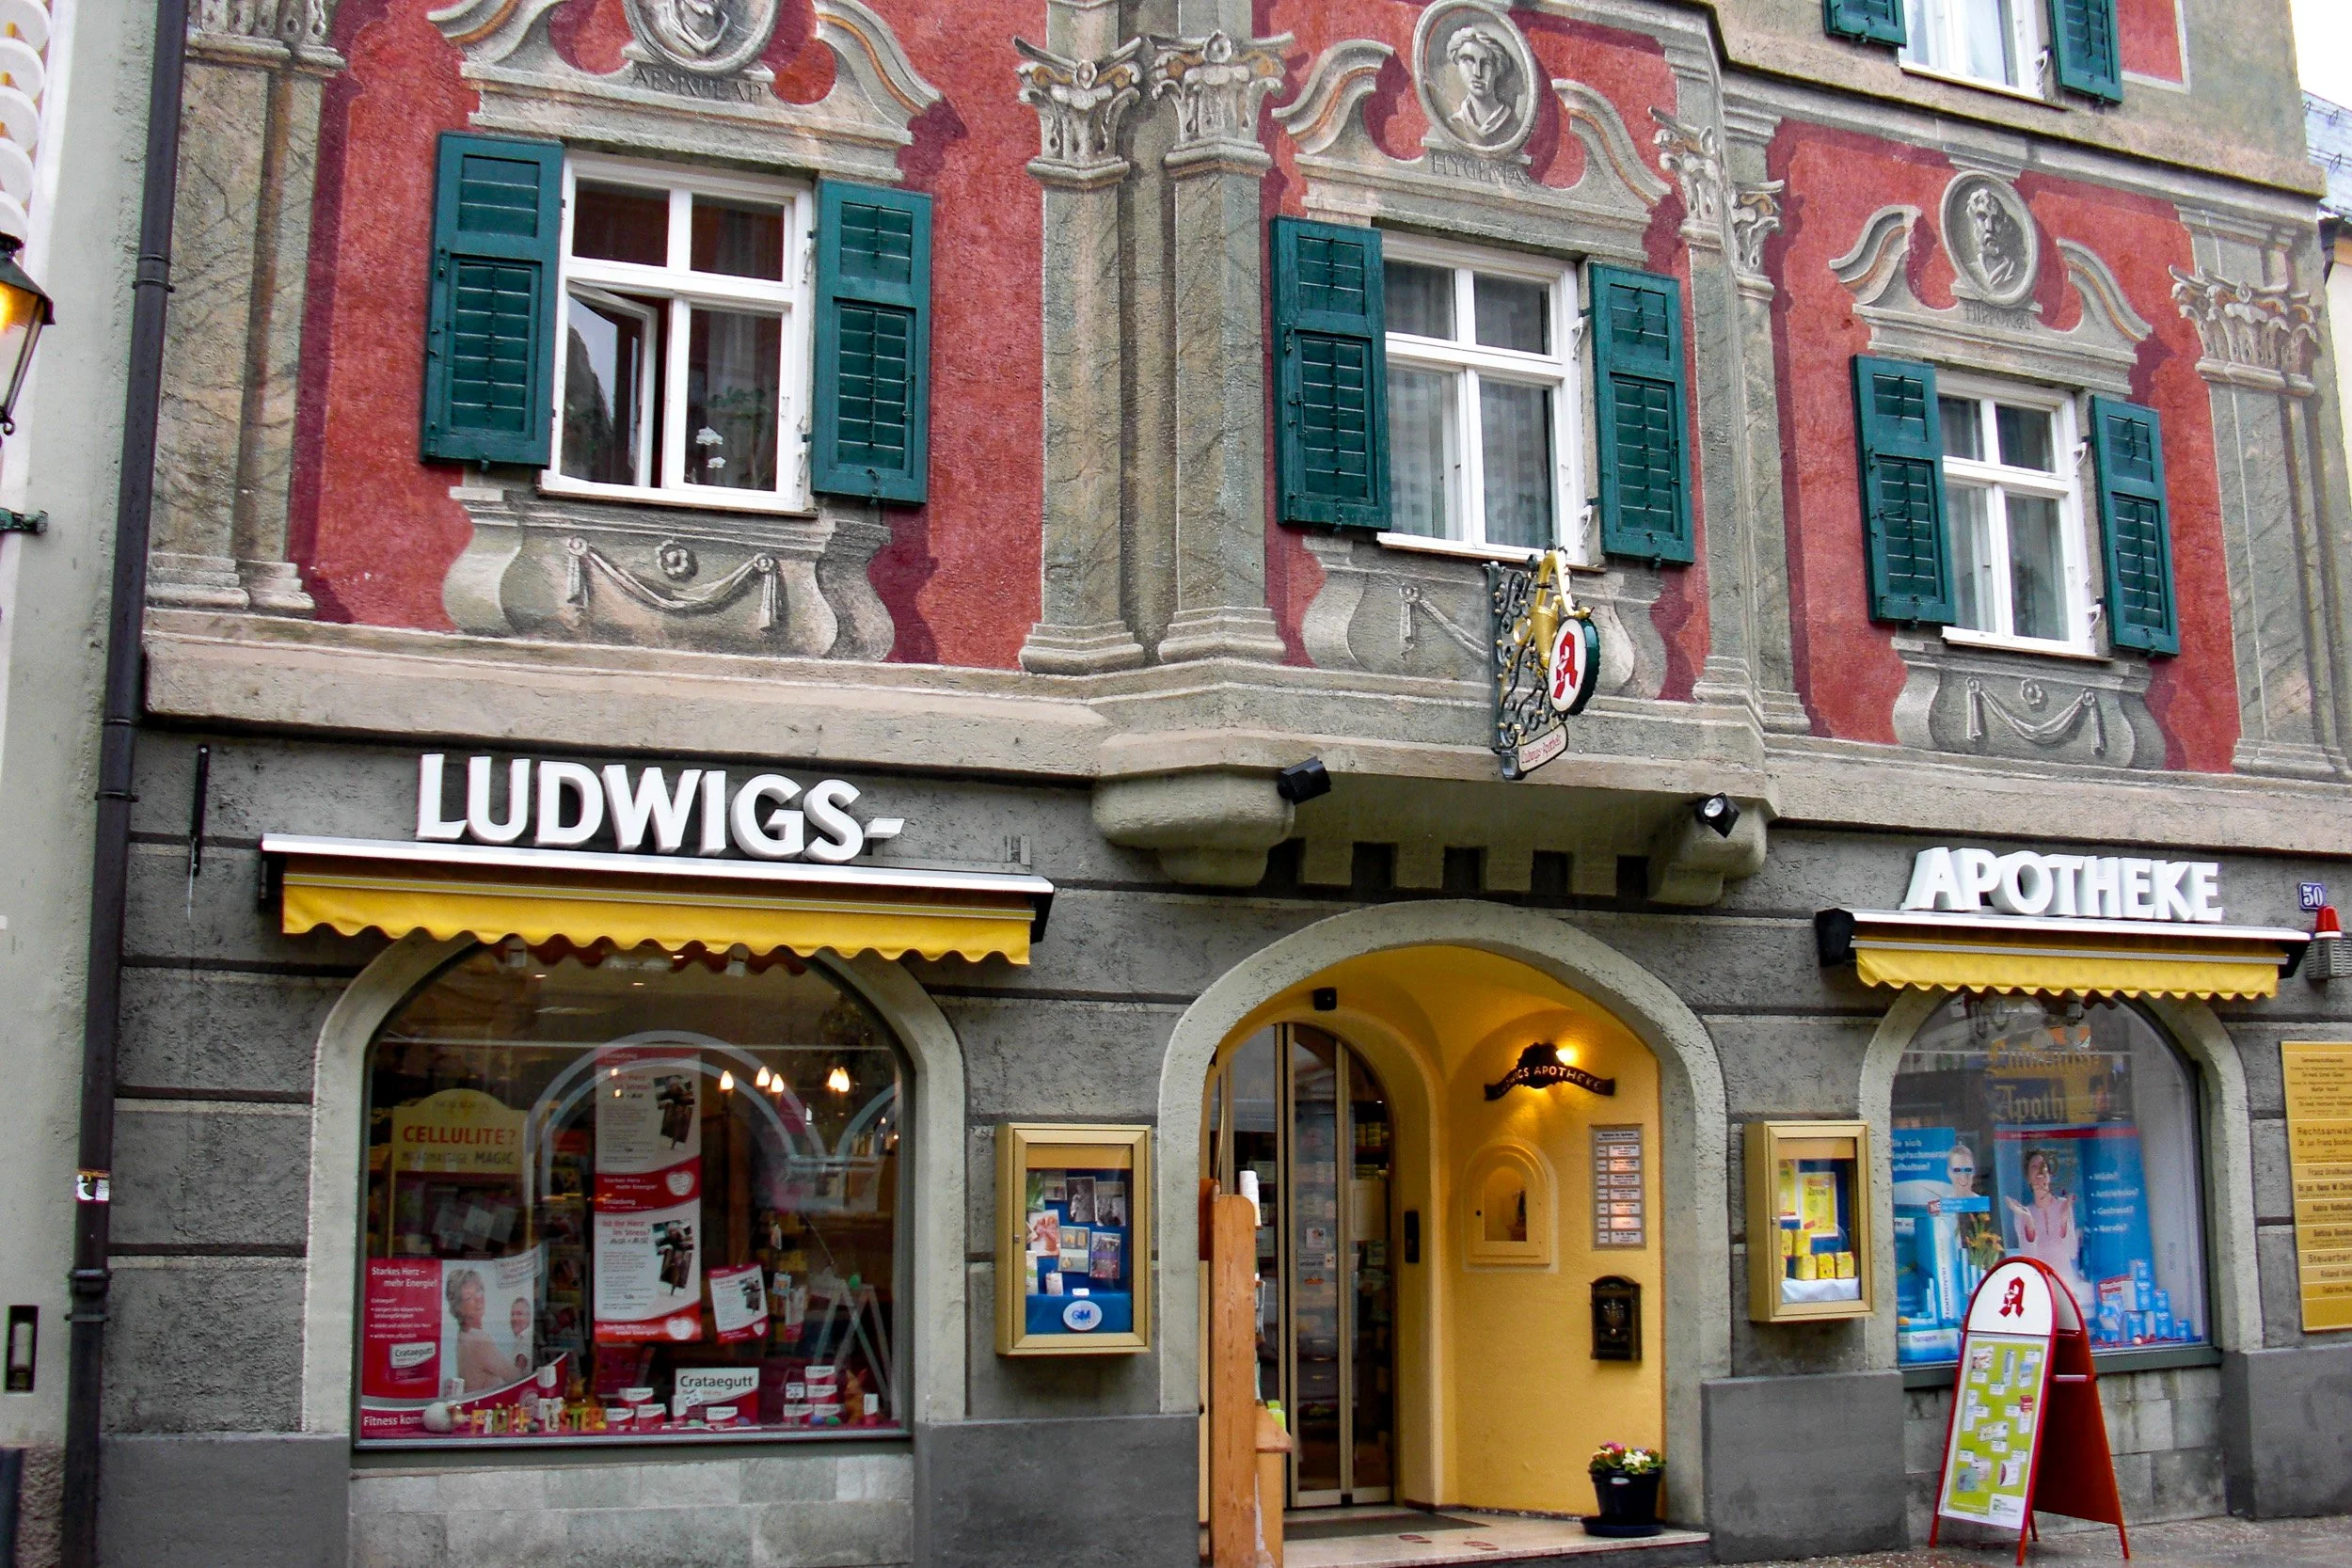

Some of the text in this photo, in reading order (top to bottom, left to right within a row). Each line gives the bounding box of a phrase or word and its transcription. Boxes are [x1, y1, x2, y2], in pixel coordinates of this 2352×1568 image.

[416, 753, 905, 864] LUDWIGS-
[1900, 847, 2223, 922] APOTHEKE
[2301, 885, 2324, 907] 50
[1534, 1065, 1601, 1091] APOTHEKE
[403, 1125, 517, 1146] CELLULITE?
[1892, 1162, 1931, 1172] ufhalten!
[372, 1266, 401, 1276] Starkes
[402, 1266, 420, 1276] Herz
[384, 1278, 437, 1289] mehr Energie!
[680, 1375, 754, 1389] Crataegutt
[363, 1415, 424, 1427] Fitness kom
